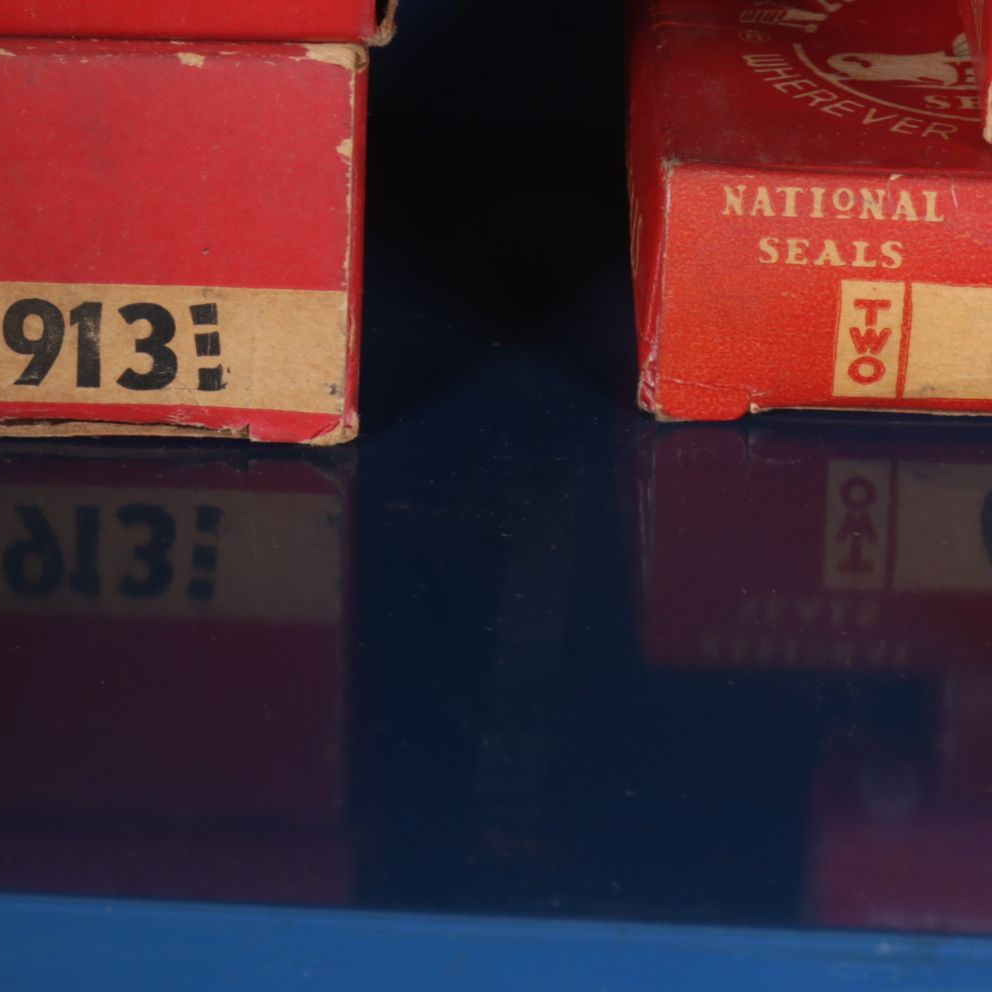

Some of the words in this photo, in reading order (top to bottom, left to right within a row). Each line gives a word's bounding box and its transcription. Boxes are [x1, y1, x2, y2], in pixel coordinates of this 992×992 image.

[742, 51, 959, 141] WHEREVER
[721, 185, 945, 223] NATIONAL
[758, 236, 905, 271] SEALS
[848, 297, 892, 386] TWO
